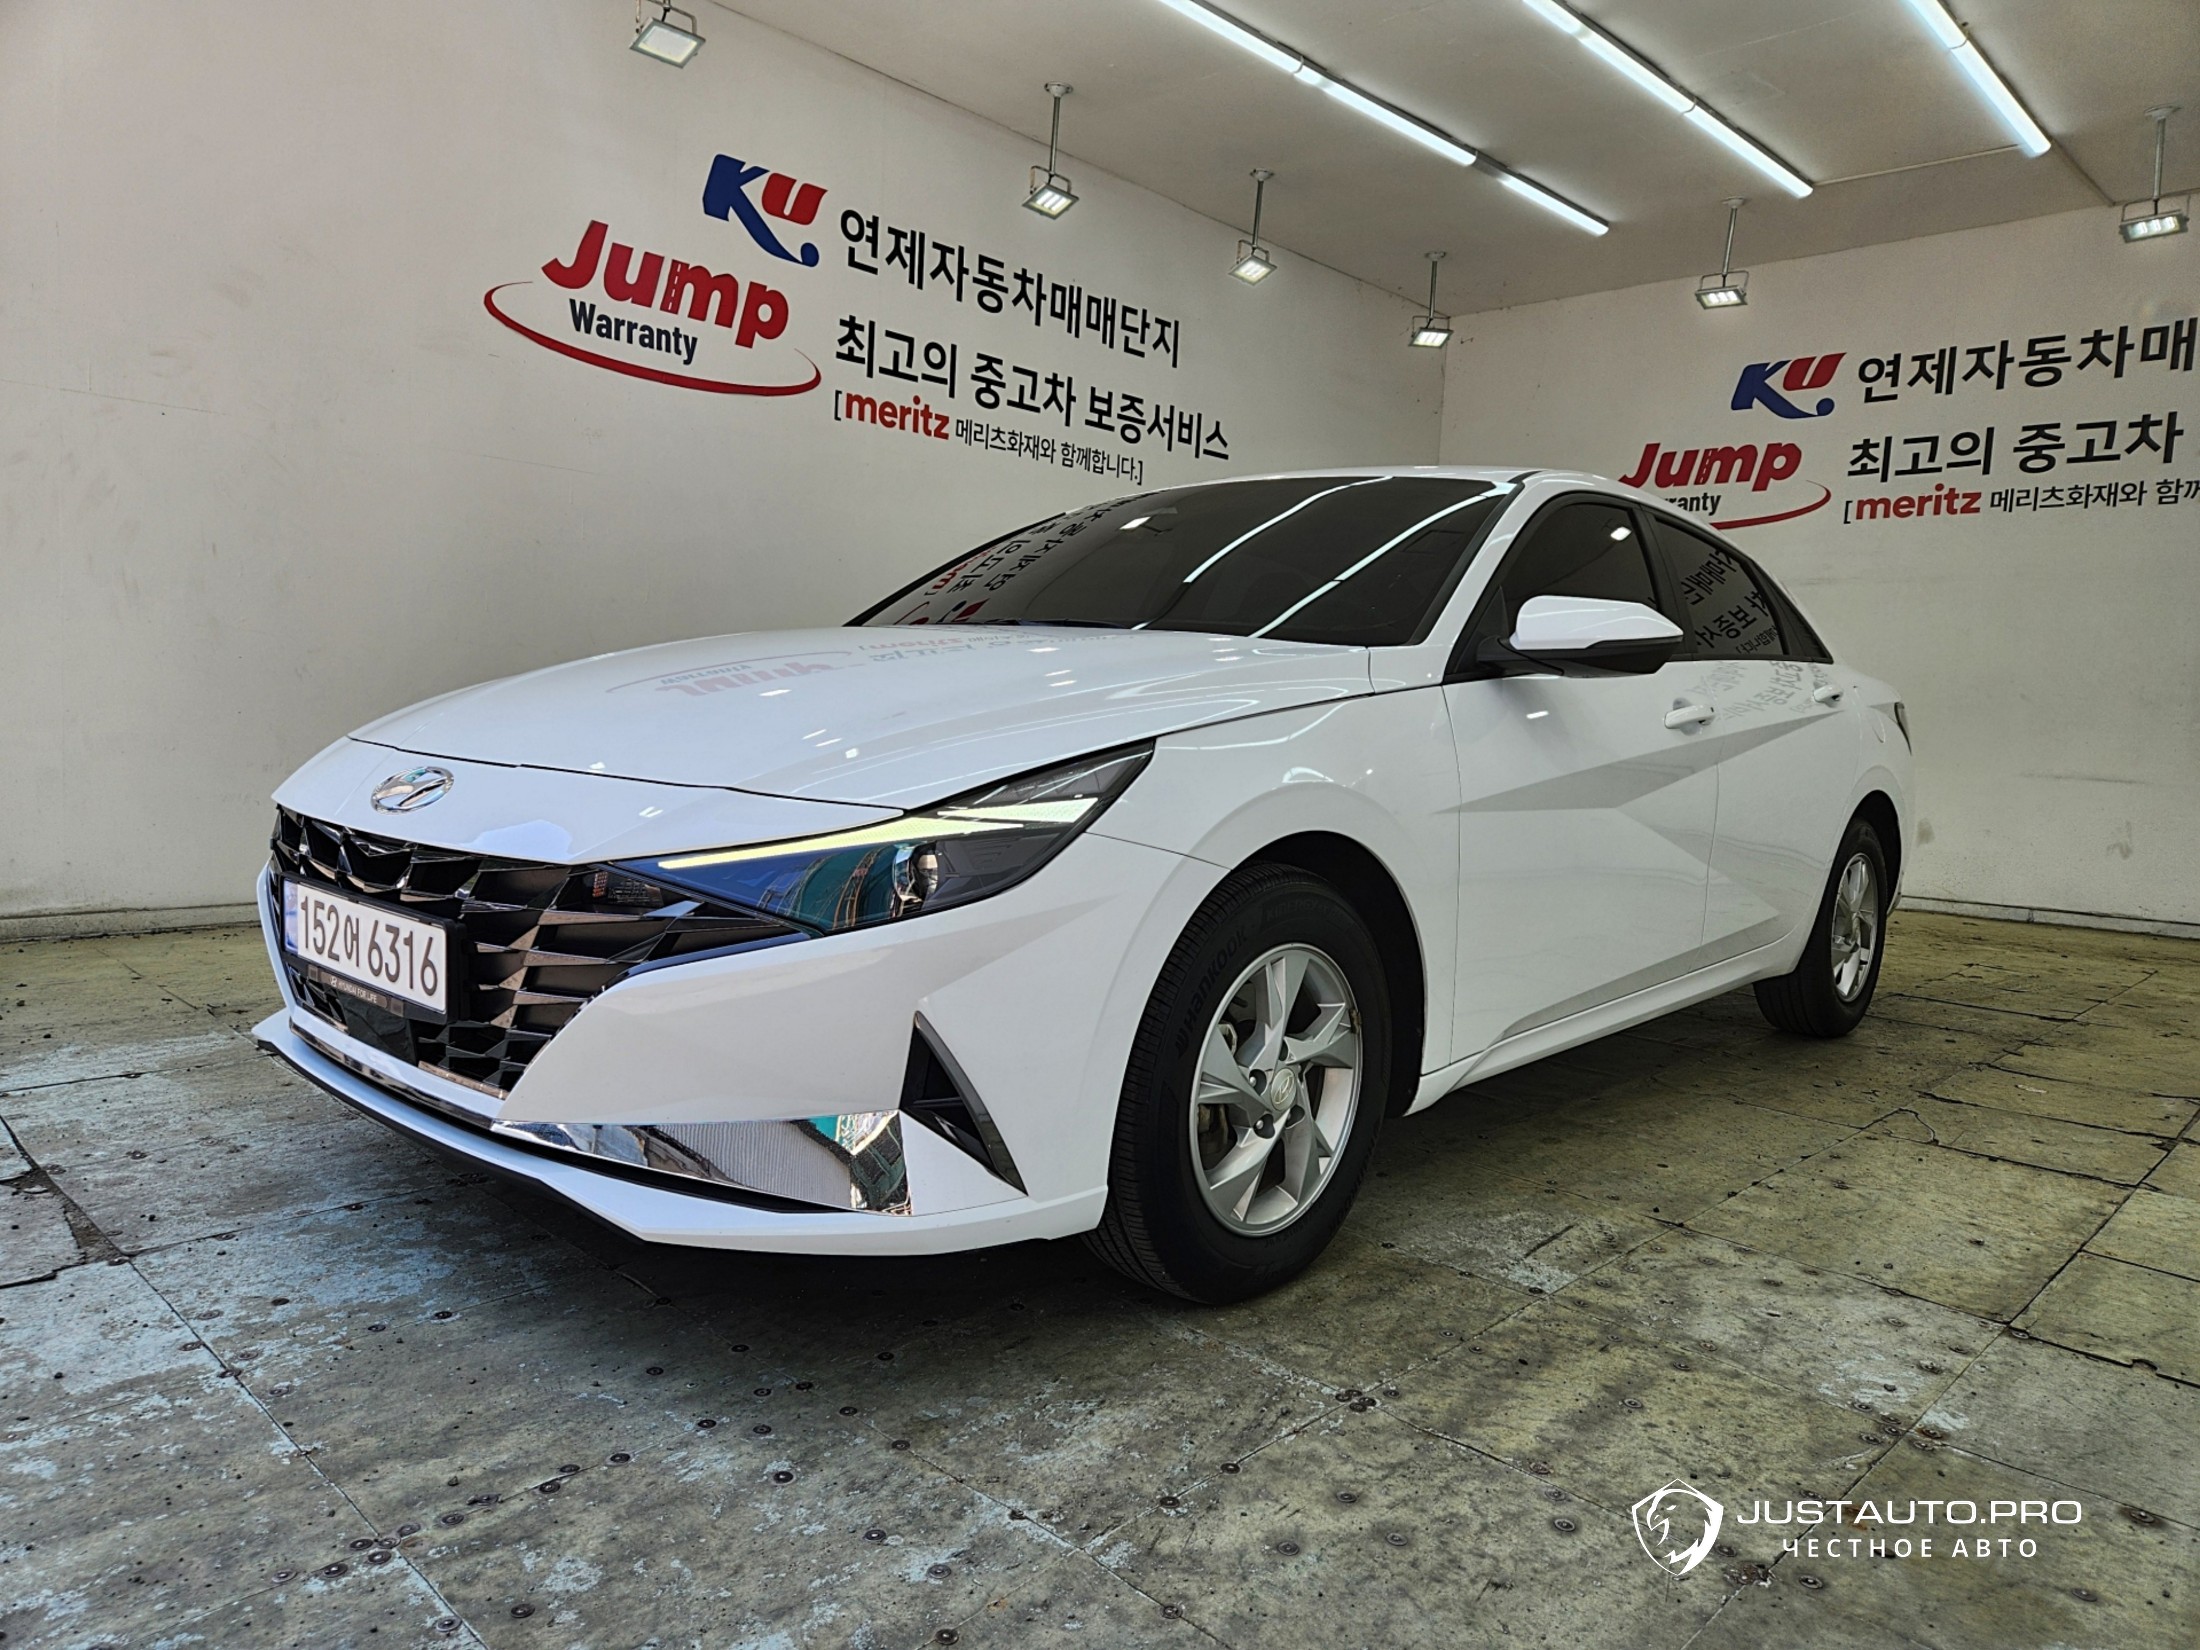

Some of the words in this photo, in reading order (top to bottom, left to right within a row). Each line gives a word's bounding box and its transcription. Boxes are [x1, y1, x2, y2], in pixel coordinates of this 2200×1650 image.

[541, 219, 788, 349] Jump
[840, 208, 1179, 368] 연제자동차매매단지
[569, 298, 697, 365] Warranty
[1858, 317, 2199, 403] 연제자동차매
[835, 314, 958, 399] 최고의
[970, 352, 1077, 427] 중고차
[1084, 385, 1230, 461] 보증서비스
[955, 418, 1057, 464] 메리츠화재와
[1618, 443, 1802, 492] Jump
[1847, 427, 1996, 483] 최고의
[2012, 411, 2184, 473] 중고차
[1990, 480, 2148, 513] 메리츠화재와
[368, 920, 438, 996] 6316
